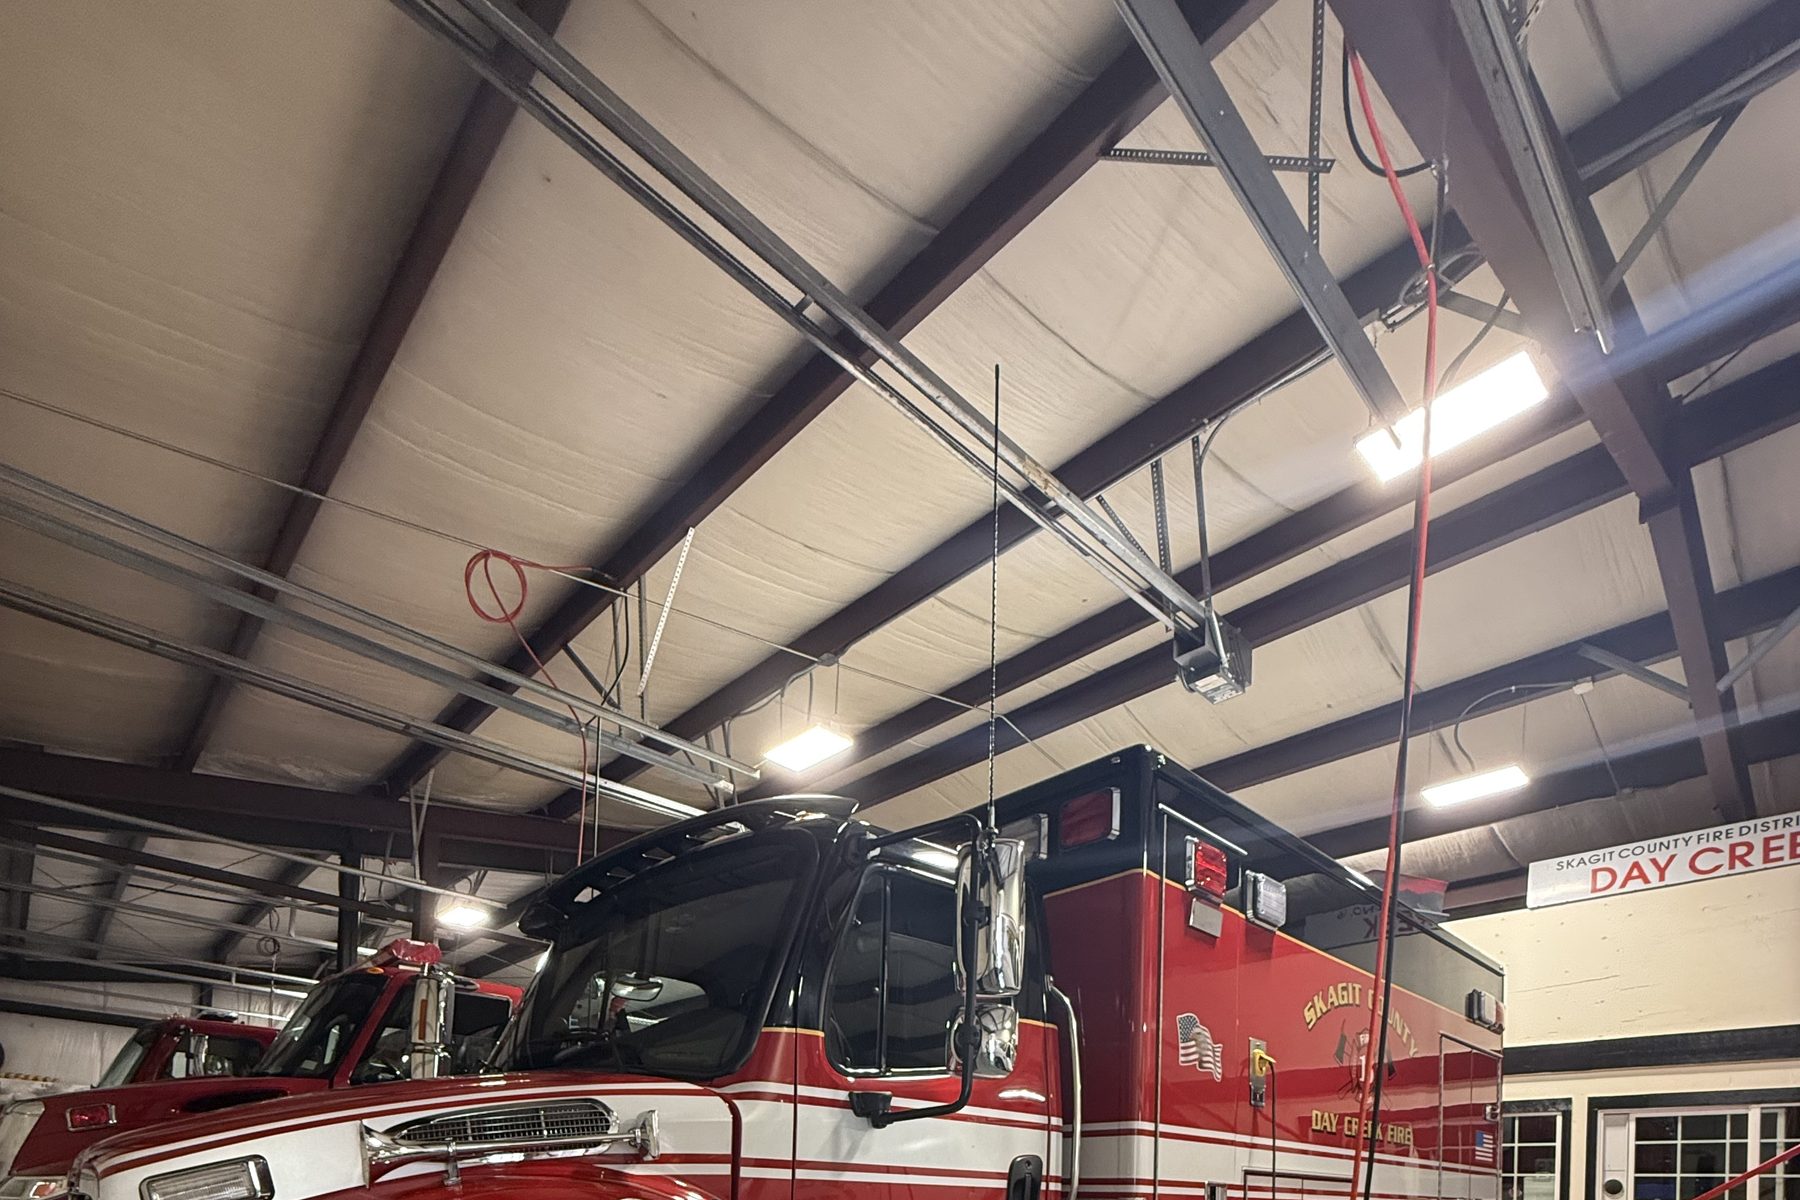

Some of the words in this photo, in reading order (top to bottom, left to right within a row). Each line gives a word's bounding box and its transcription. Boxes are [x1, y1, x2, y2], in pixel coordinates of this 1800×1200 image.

[1556, 851, 1615, 871] SKAGIT
[1618, 835, 1693, 859] COUNTY
[1697, 828, 1734, 845] FIRE
[1739, 815, 1800, 837] DISTRI
[1590, 853, 1678, 894] DAY
[1304, 982, 1362, 1031] SKAGIT
[1311, 1109, 1339, 1134] DAY
[1387, 1124, 1413, 1147] FIRE
